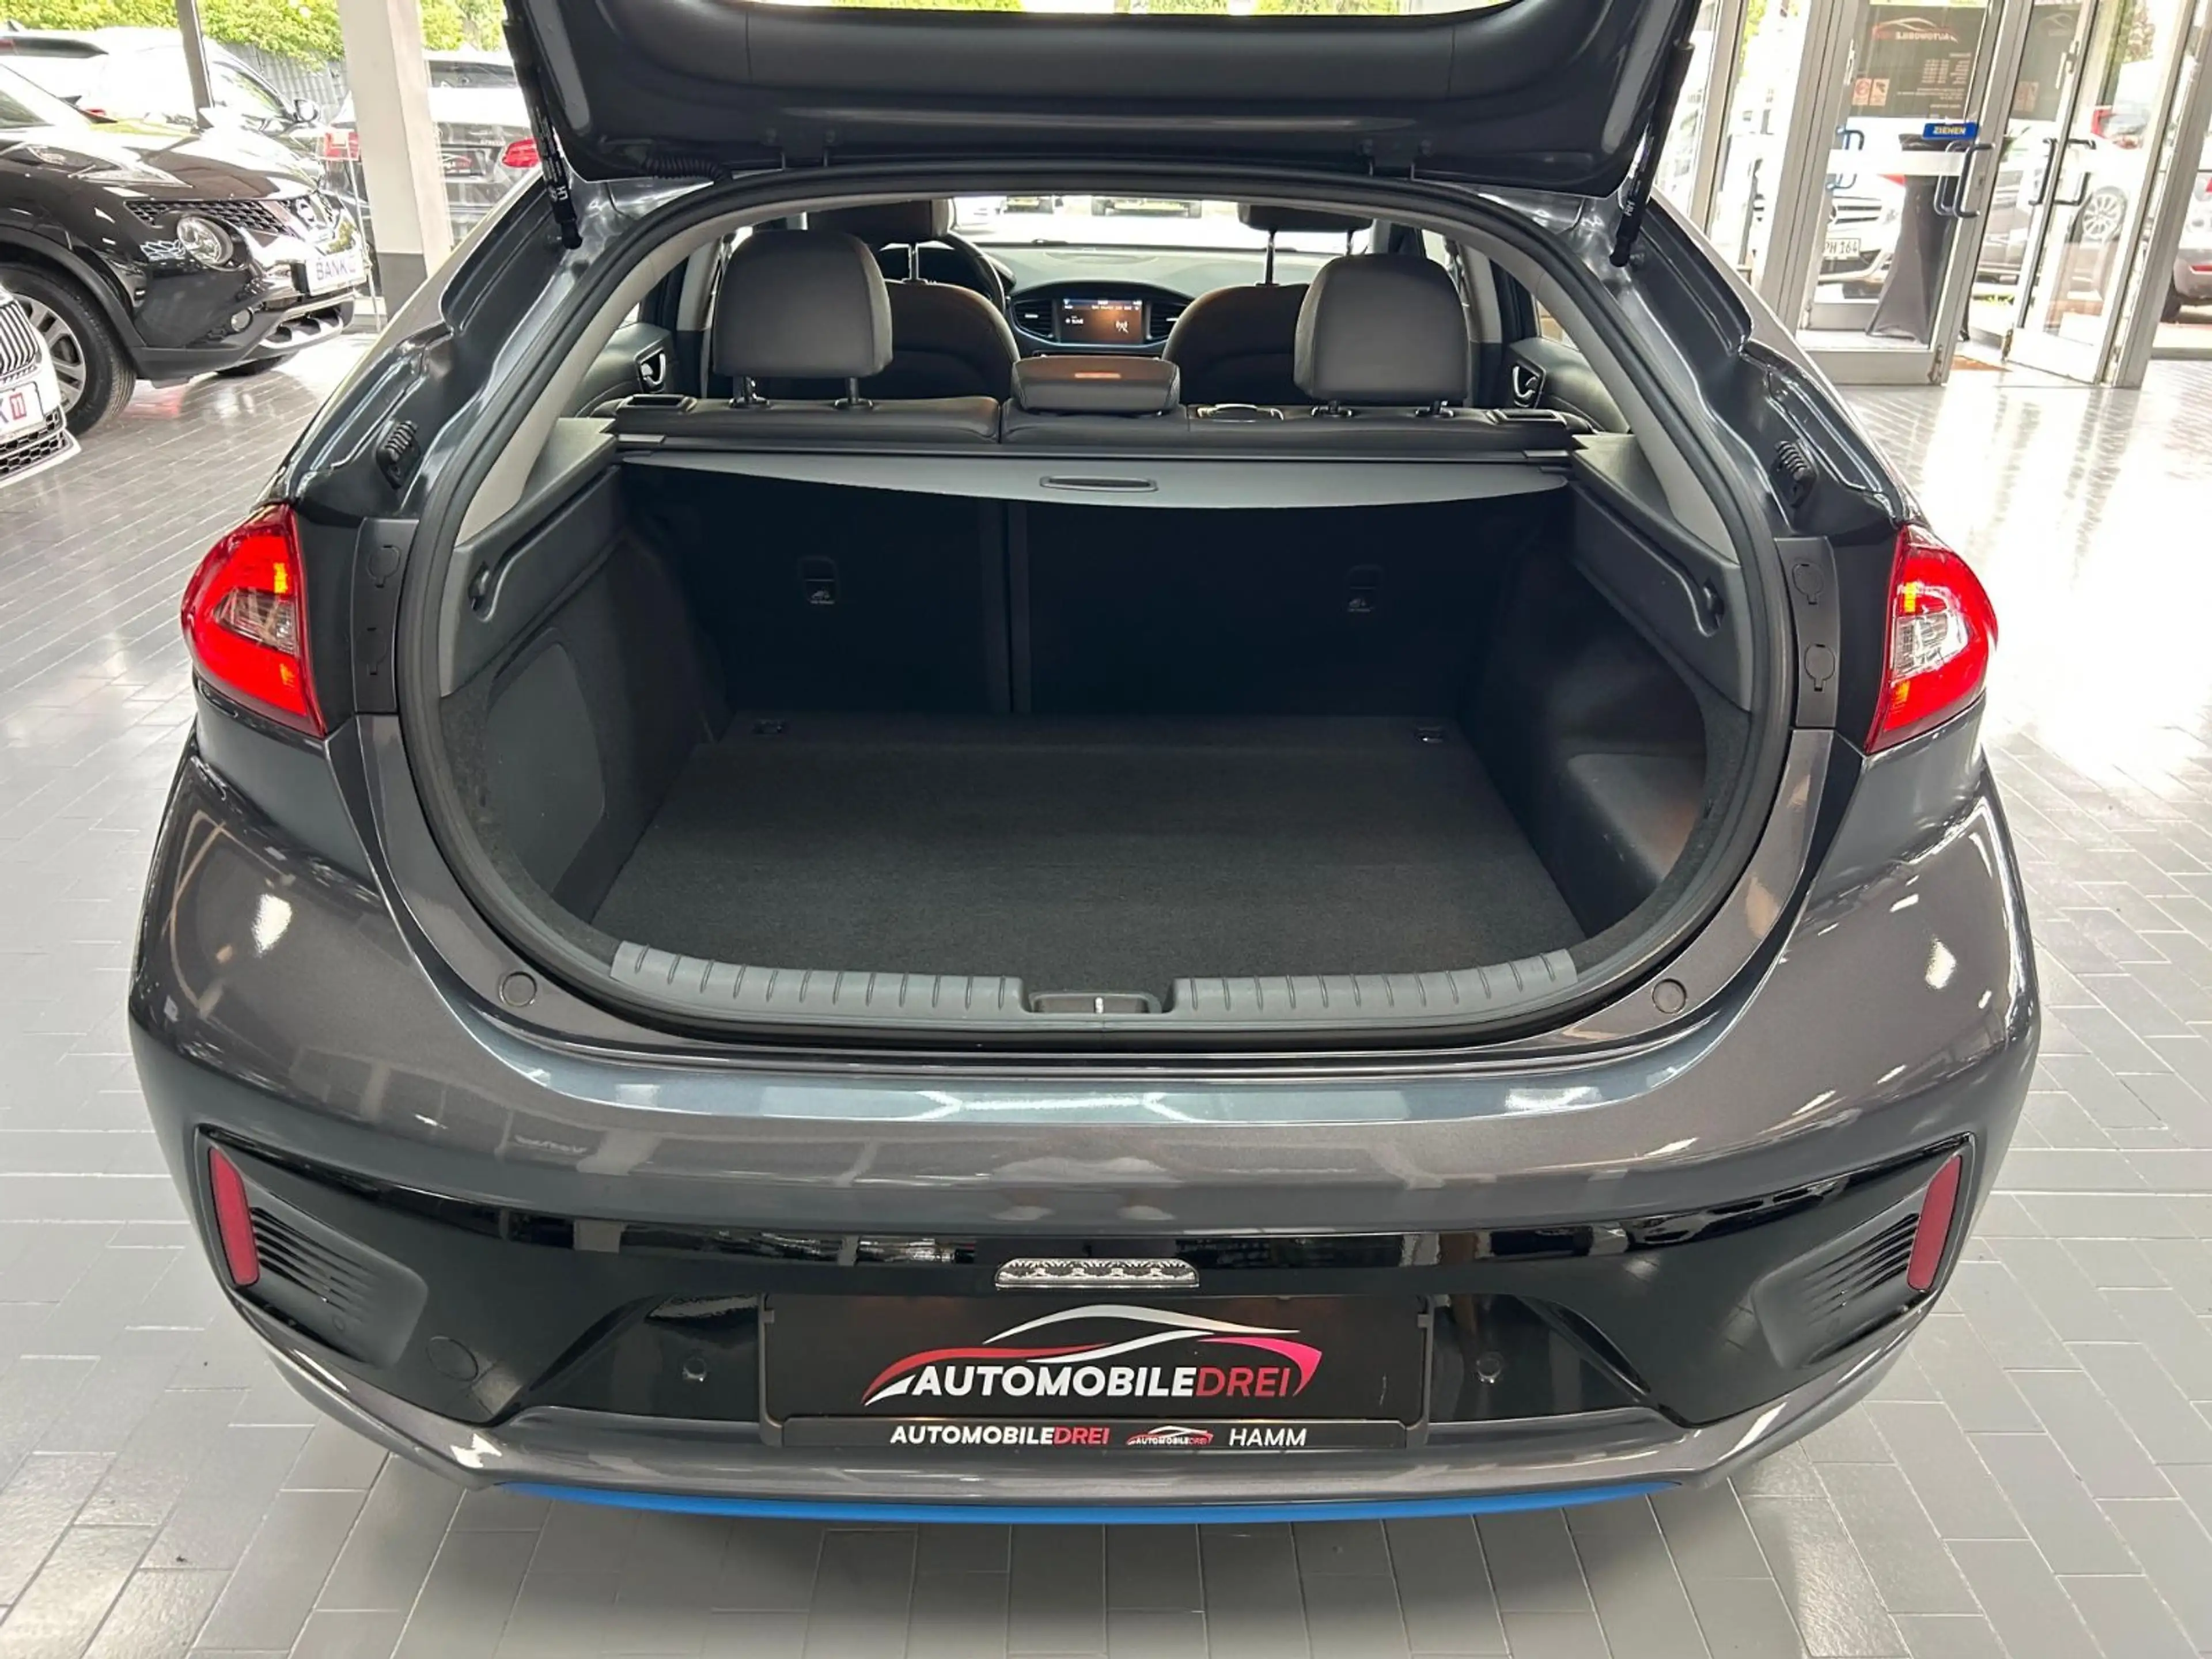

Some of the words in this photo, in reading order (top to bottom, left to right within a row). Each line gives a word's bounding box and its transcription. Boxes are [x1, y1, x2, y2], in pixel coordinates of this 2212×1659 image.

[316, 258, 348, 281] BANK
[911, 1366, 1290, 1396] AUTOMOBILEDREI
[890, 1426, 1109, 1444] AUTOMOBILEDREI
[1229, 1428, 1306, 1446] HAMM
